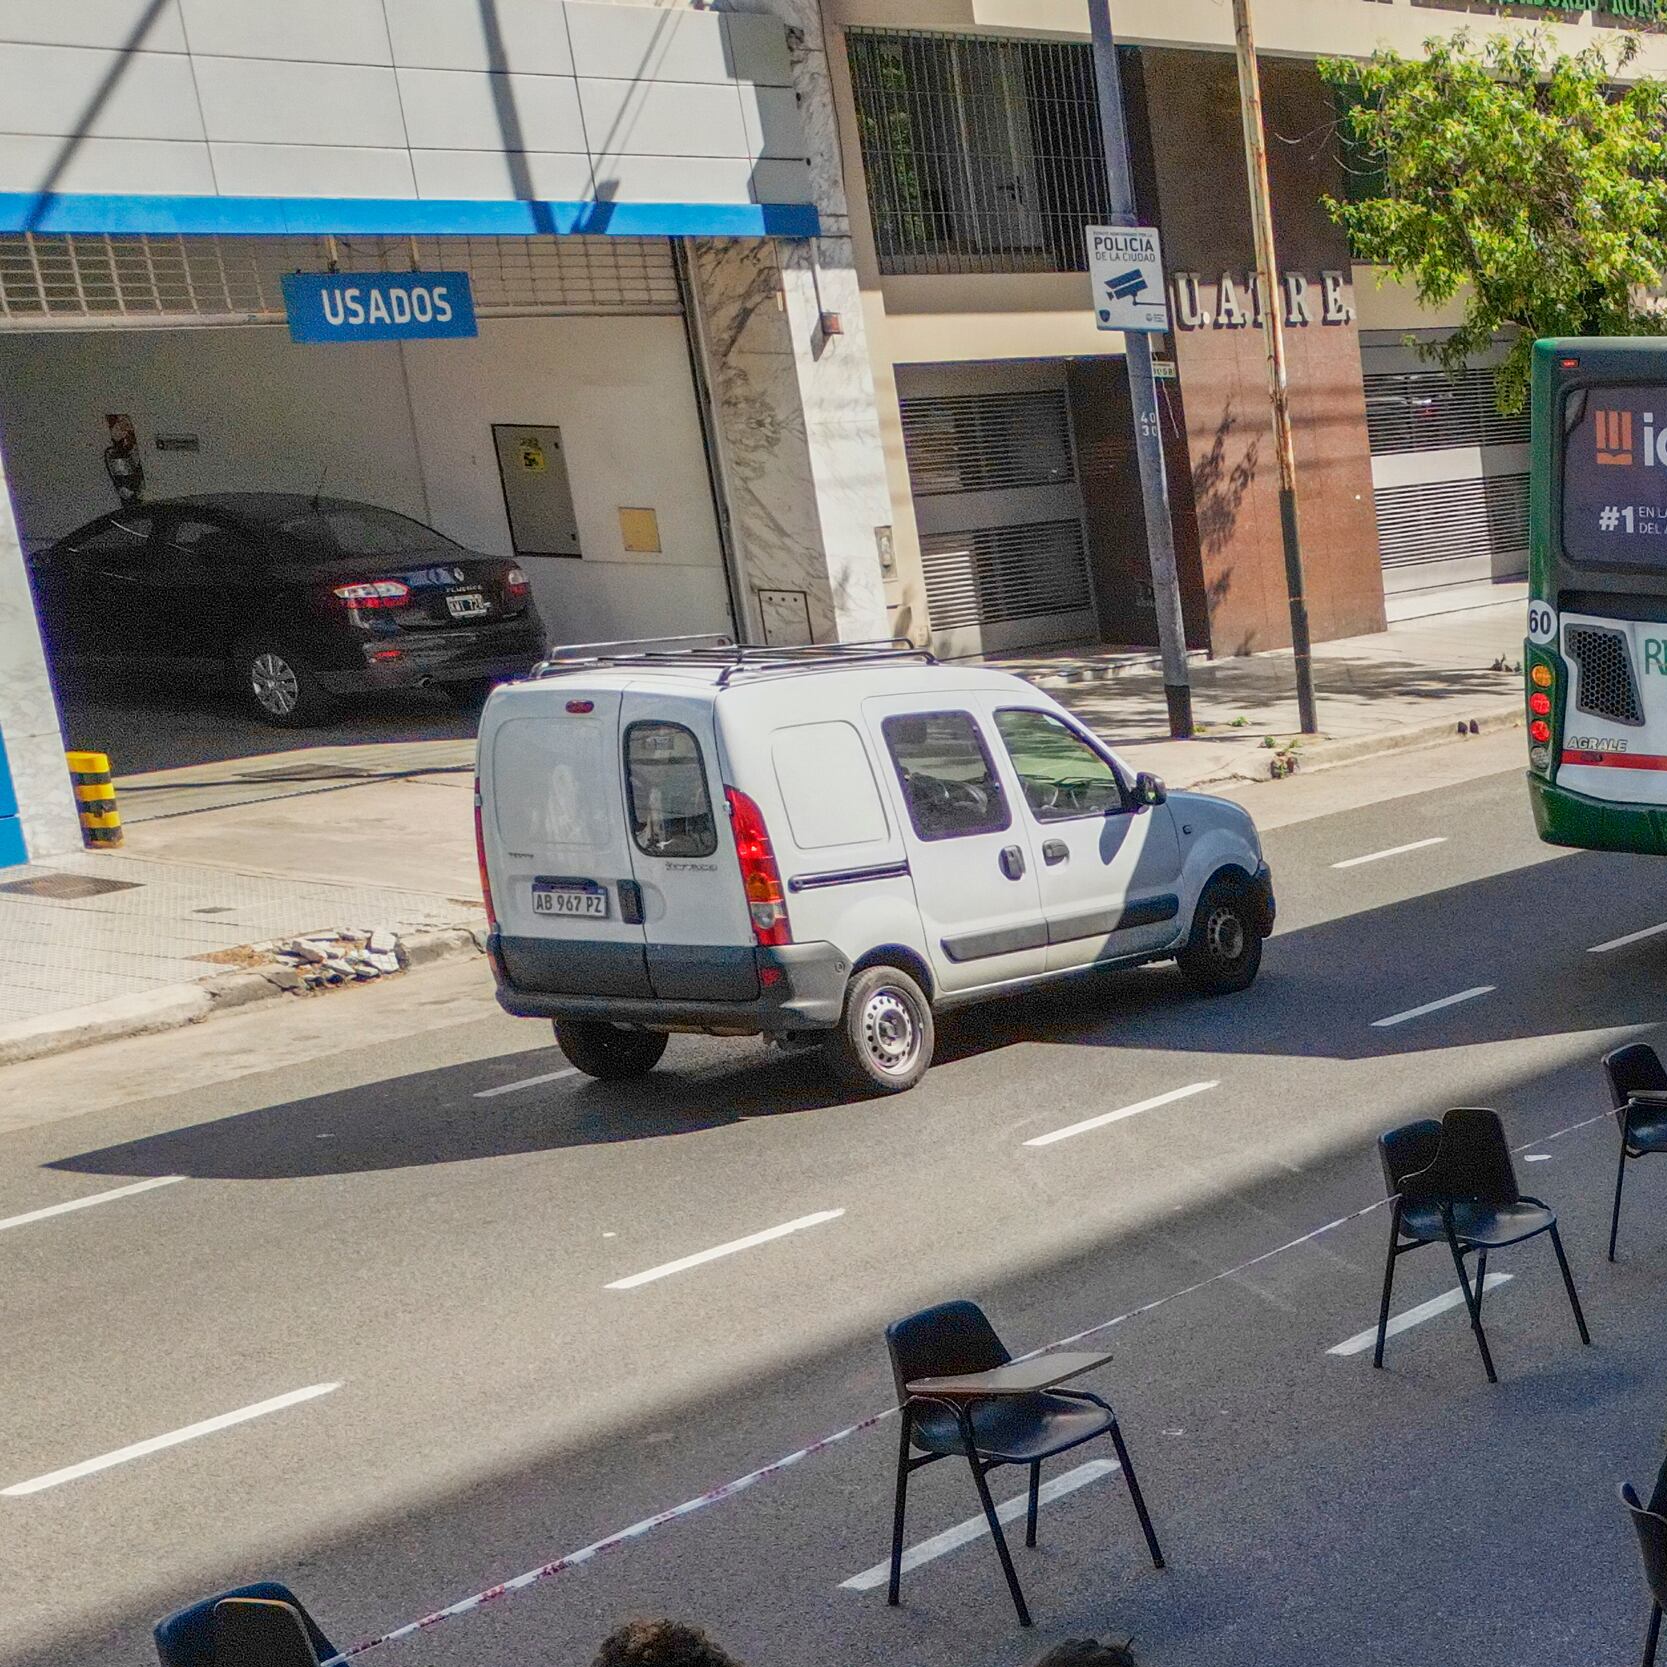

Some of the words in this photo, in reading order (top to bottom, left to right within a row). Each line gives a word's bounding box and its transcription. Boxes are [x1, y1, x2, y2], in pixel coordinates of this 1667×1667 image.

[1095, 252, 1107, 261] DE
[1109, 253, 1120, 261] LA
[1122, 253, 1156, 262] CIUDAD
[321, 287, 453, 326] USADOS
[1599, 506, 1635, 533] #1
[1638, 506, 1655, 518] EN
[1639, 522, 1663, 535] DEL
[1529, 610, 1551, 635] 60
[1567, 735, 1628, 752] AGRALE
[536, 893, 553, 911] AB
[557, 894, 582, 912] 967
[586, 896, 602, 913] PZ
